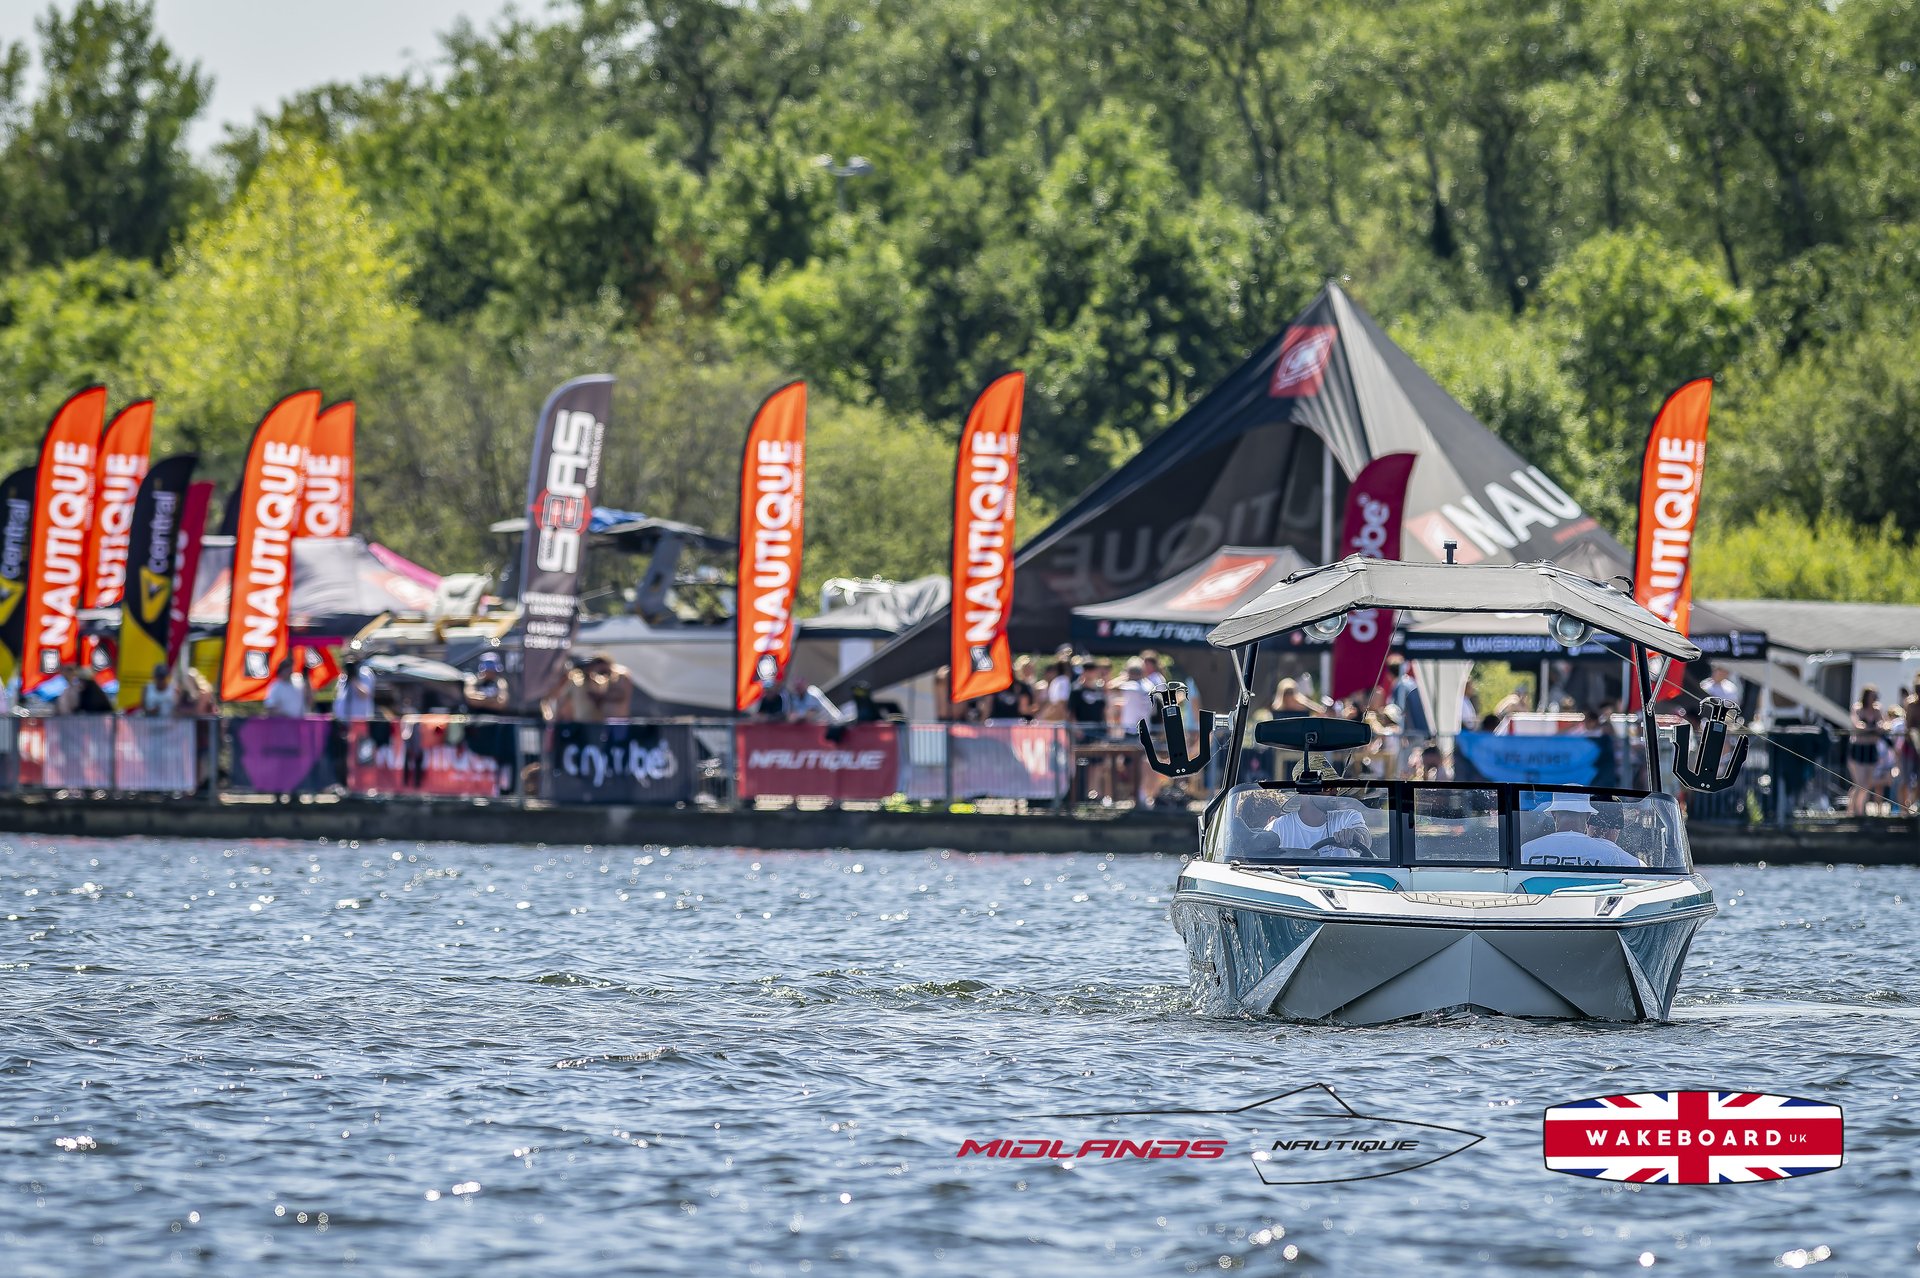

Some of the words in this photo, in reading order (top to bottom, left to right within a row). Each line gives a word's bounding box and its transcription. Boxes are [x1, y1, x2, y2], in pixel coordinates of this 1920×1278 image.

[39, 441, 89, 646] NAUTIQUE
[243, 441, 301, 648] NAUTIQUE
[753, 440, 793, 652] NAUTIQUE
[965, 431, 1009, 642] NAUTIQUE
[1440, 465, 1582, 556] NAU
[1648, 437, 1695, 628] AUTIQUE
[748, 749, 887, 771] NAUTIQUE
